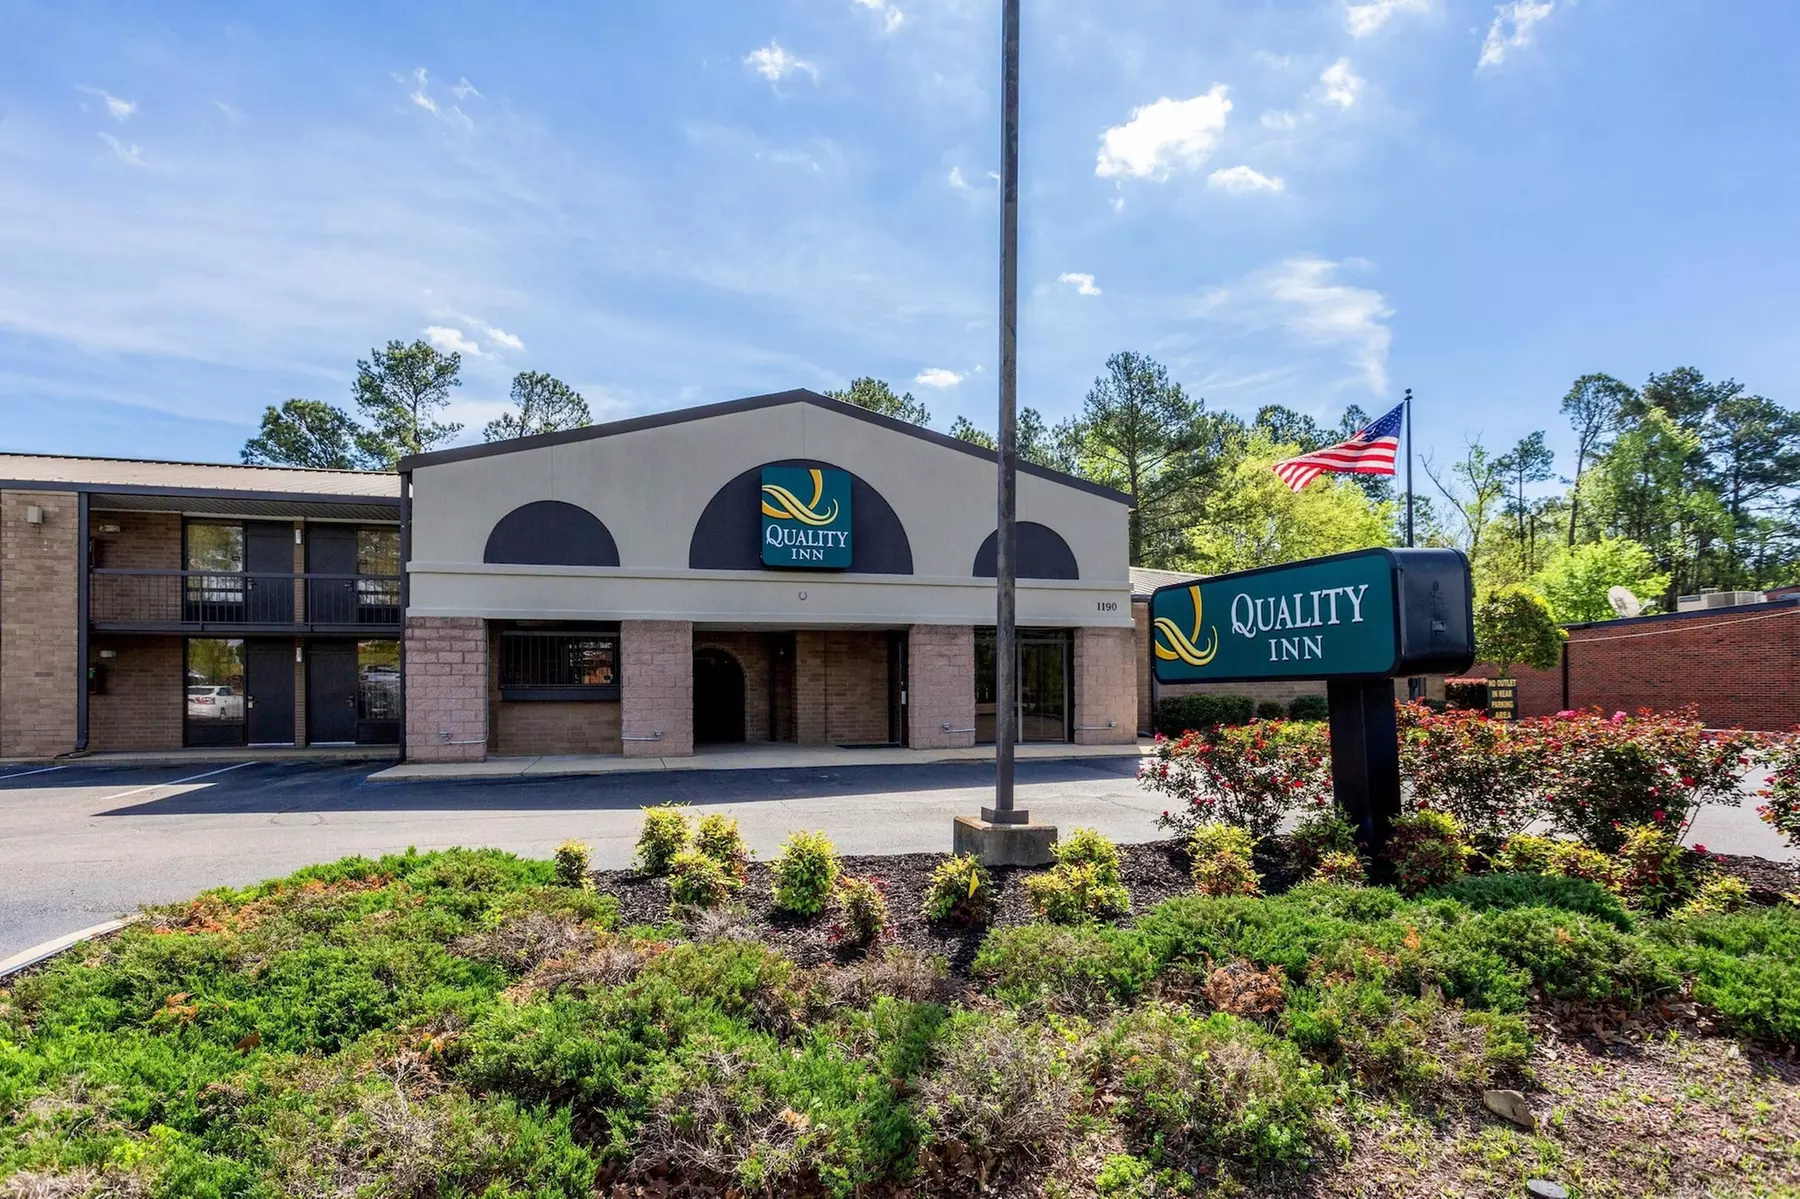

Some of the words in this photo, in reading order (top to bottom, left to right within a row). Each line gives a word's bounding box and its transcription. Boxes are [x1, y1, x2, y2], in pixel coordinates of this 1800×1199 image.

[766, 524, 849, 548] QUALITY
[791, 548, 824, 561] INN
[1097, 602, 1117, 611] 1190
[1231, 584, 1369, 638] QUALITY
[1269, 635, 1323, 661] INN
[1488, 679, 1496, 687] NO
[1496, 679, 1516, 687] OUTLET
[1498, 690, 1512, 698] REAR
[1491, 701, 1514, 709] PARKING
[1494, 711, 1512, 719] AREA
